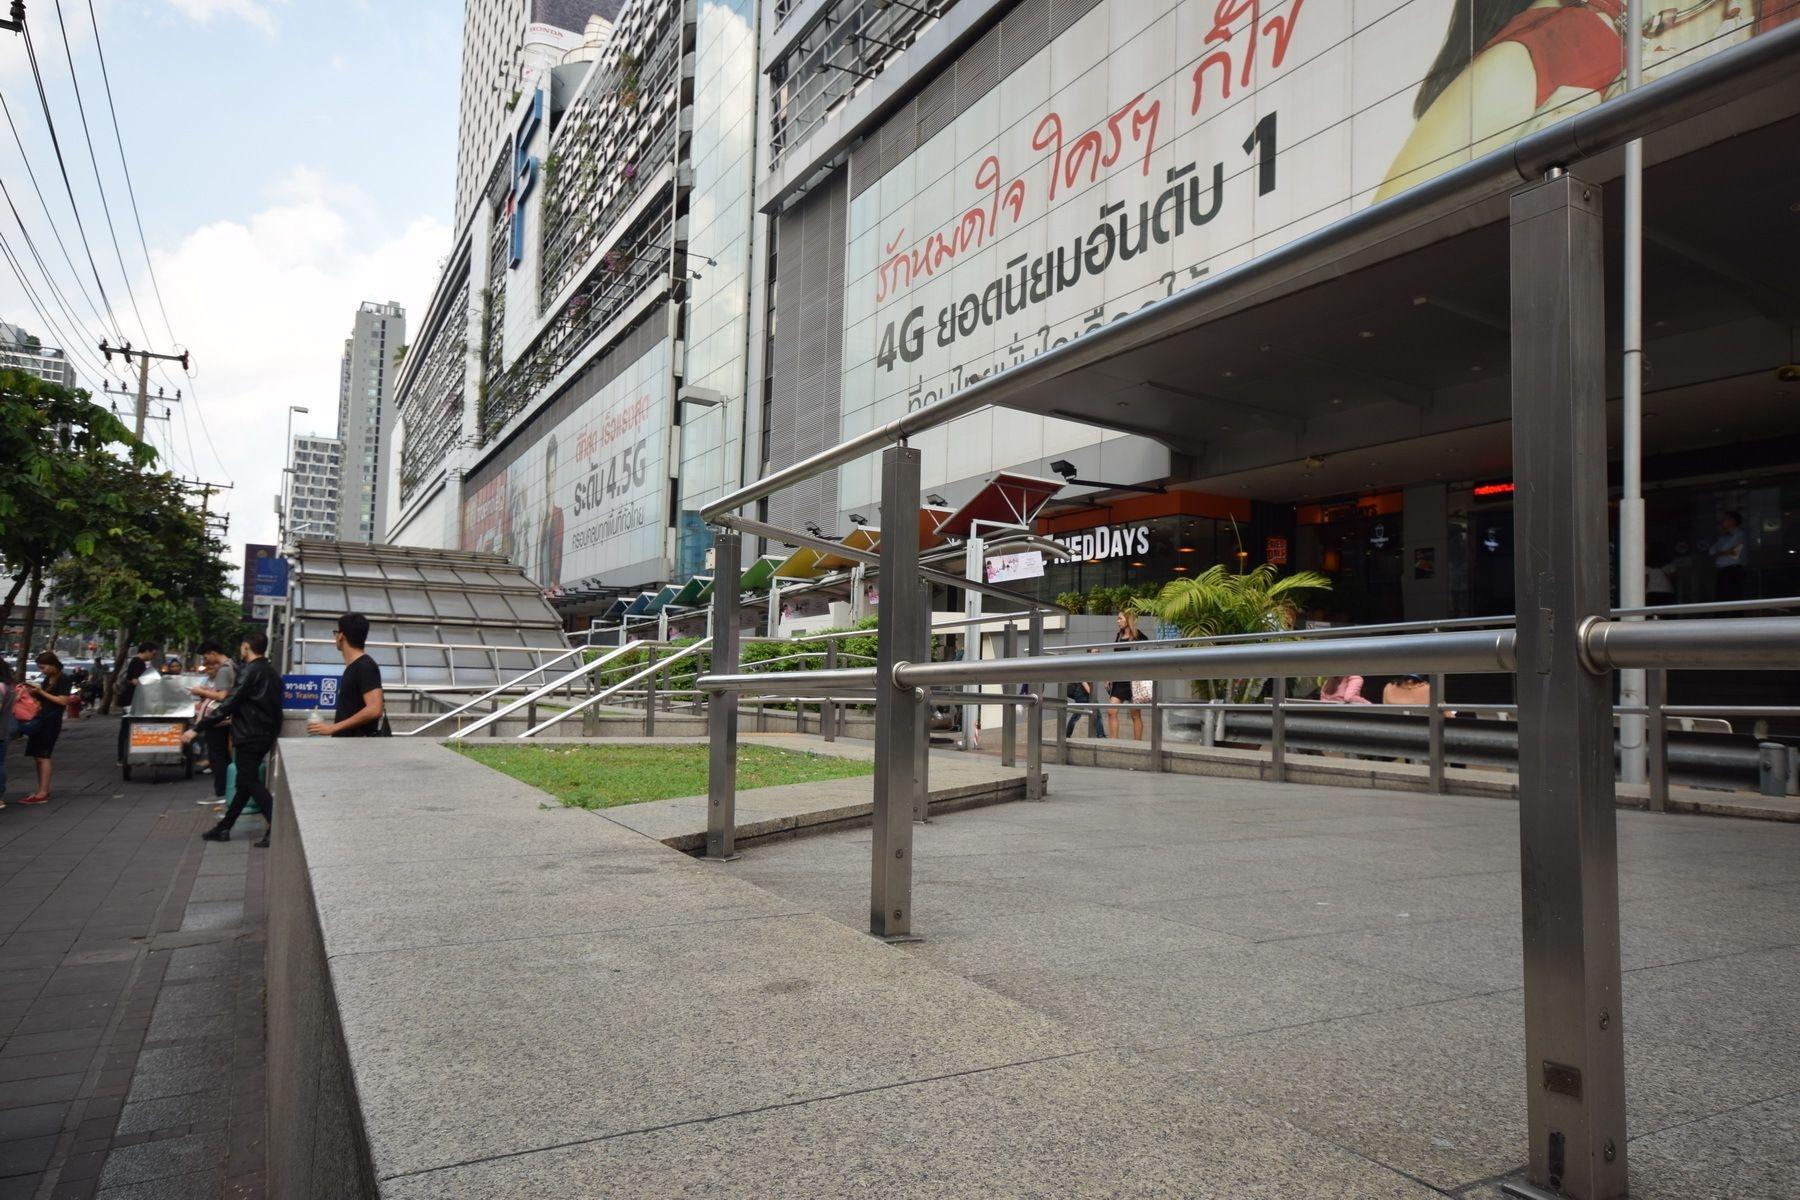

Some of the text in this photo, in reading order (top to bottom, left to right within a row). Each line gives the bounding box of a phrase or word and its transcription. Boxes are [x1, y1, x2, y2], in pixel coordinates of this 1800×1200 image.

[876, 155, 1025, 303] รักหมดใจ
[1032, 92, 1161, 201] ใครๆ
[877, 305, 925, 373] 4G
[936, 161, 1224, 348] ยอดนิยมอันดับ
[1242, 111, 1277, 197] 1
[574, 462, 604, 516] ระดับ
[606, 438, 646, 499] 4.5G
[285, 681, 318, 690] ทางเข้า
[296, 691, 319, 700] Trains
